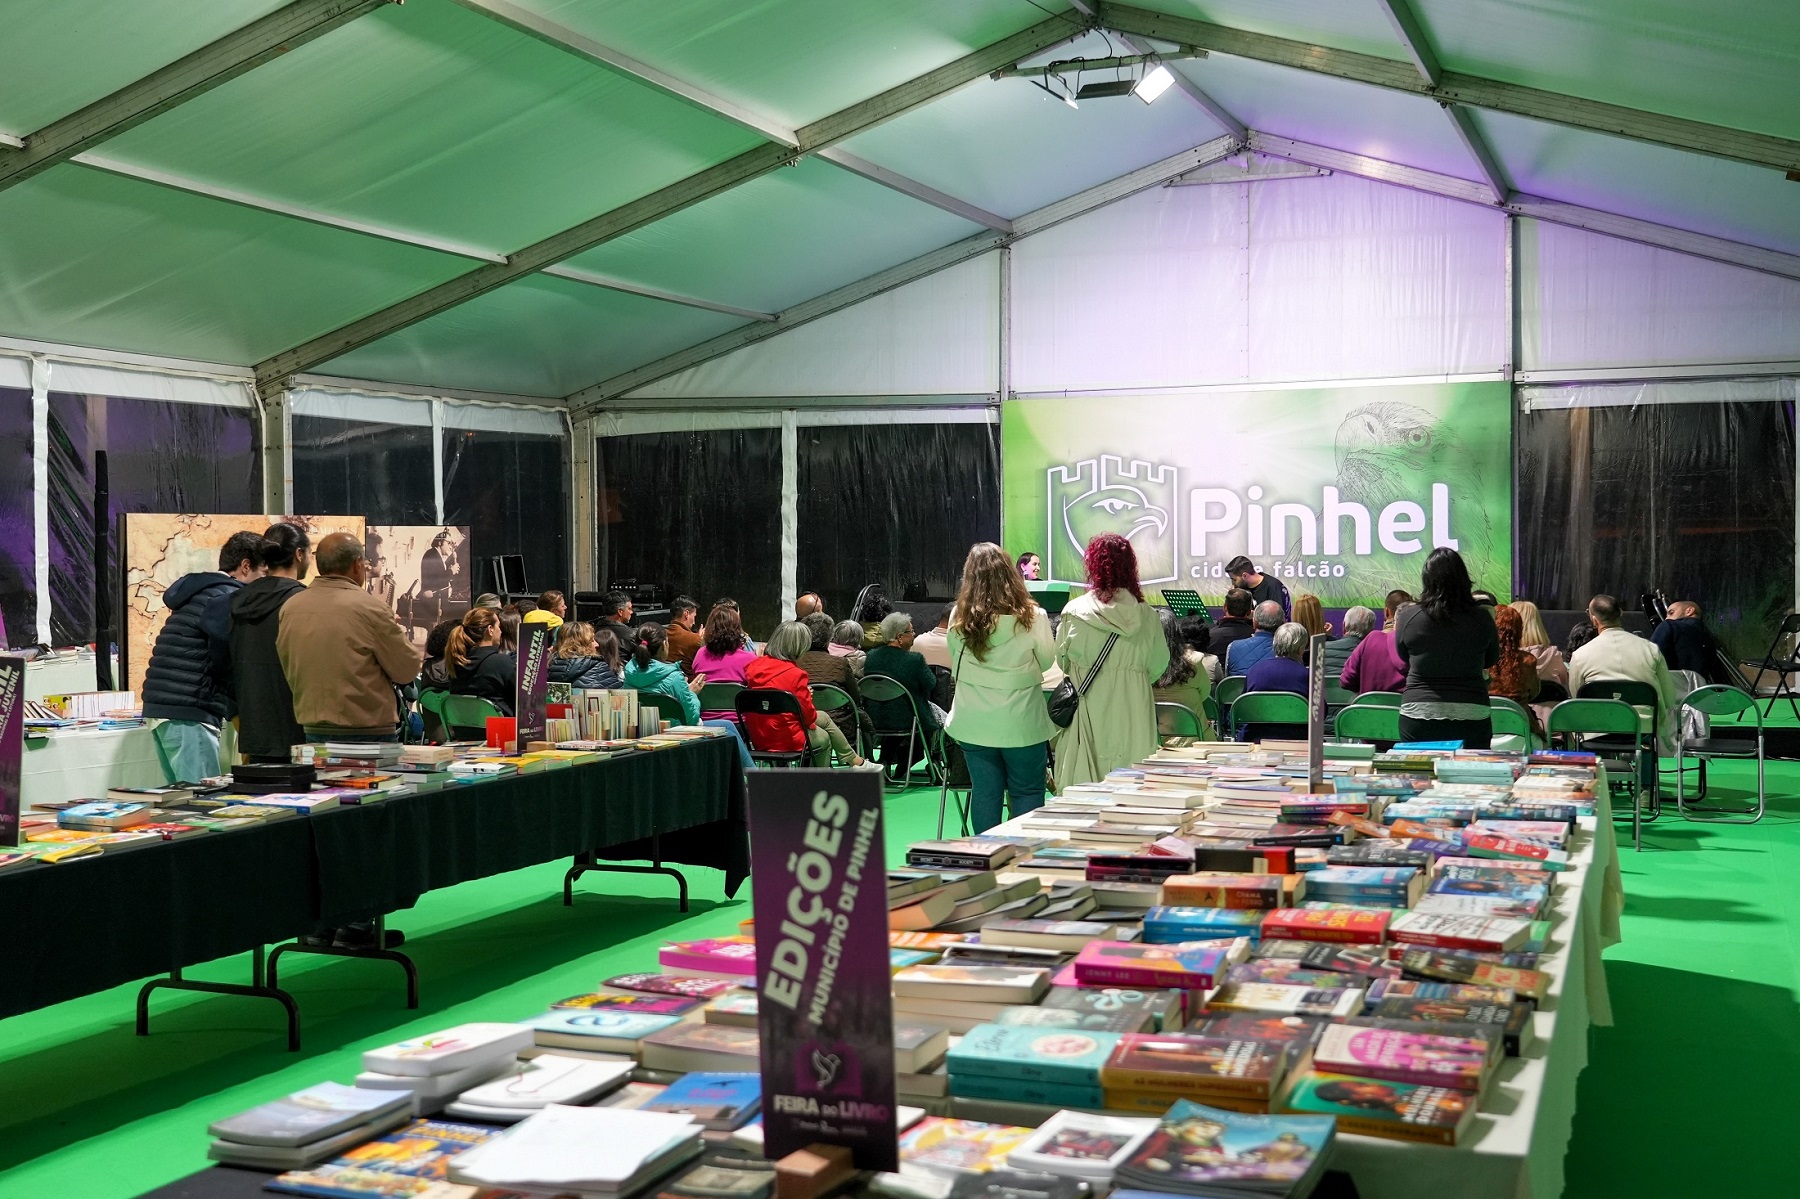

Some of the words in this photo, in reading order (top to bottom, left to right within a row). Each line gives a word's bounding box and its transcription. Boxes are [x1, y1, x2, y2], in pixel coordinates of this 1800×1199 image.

[1190, 483, 1459, 556] Pinhel
[1190, 561, 1264, 578] cide
[1273, 561, 1345, 577] falcão
[1, 669, 20, 713] JUVENIL
[521, 629, 541, 691] INFANTIL
[845, 807, 879, 881] PINHEL
[763, 790, 849, 1009] EDIÇÕES
[837, 881, 859, 912] DE
[807, 913, 850, 1025] MUNICÍPIO
[774, 1094, 819, 1116] FEIRA
[839, 1101, 888, 1121] LIVRO
